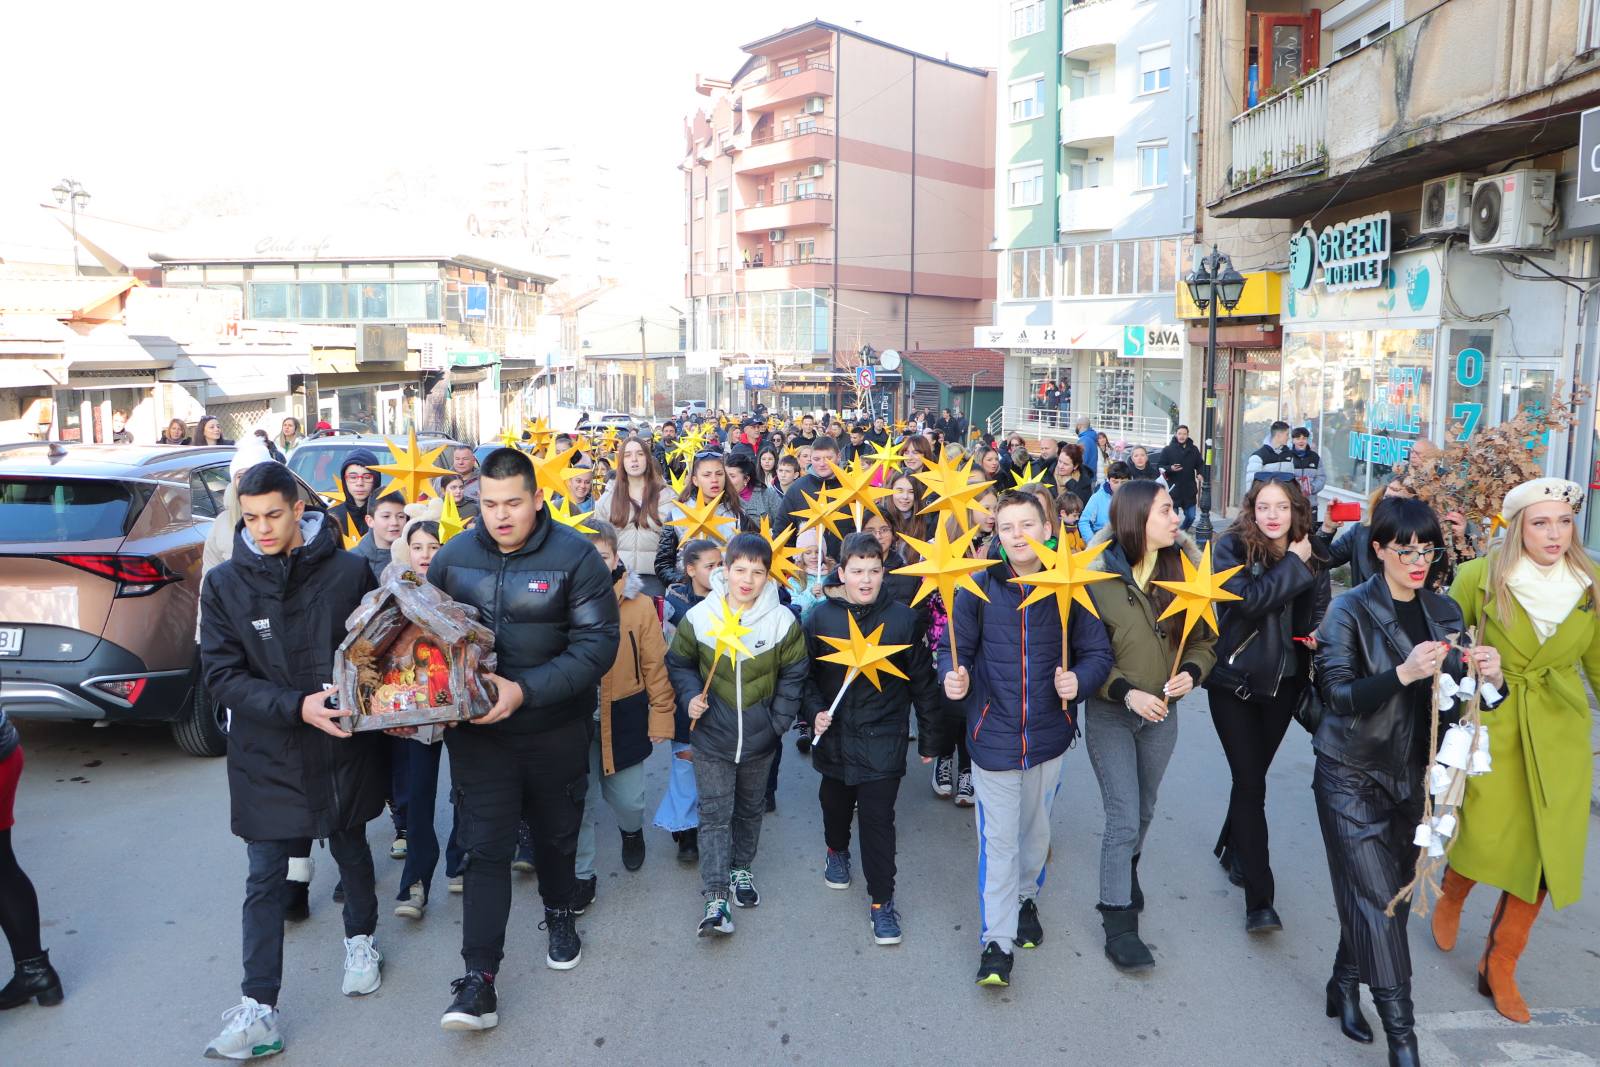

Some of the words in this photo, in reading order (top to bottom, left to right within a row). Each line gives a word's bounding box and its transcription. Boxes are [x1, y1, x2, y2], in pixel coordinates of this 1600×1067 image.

[1319, 219, 1386, 263] GREEN
[1325, 259, 1378, 286] MOBILE
[1148, 331, 1180, 346] SAVA
[1365, 400, 1421, 434] MOBILE
[1348, 430, 1416, 467] INTERNE
